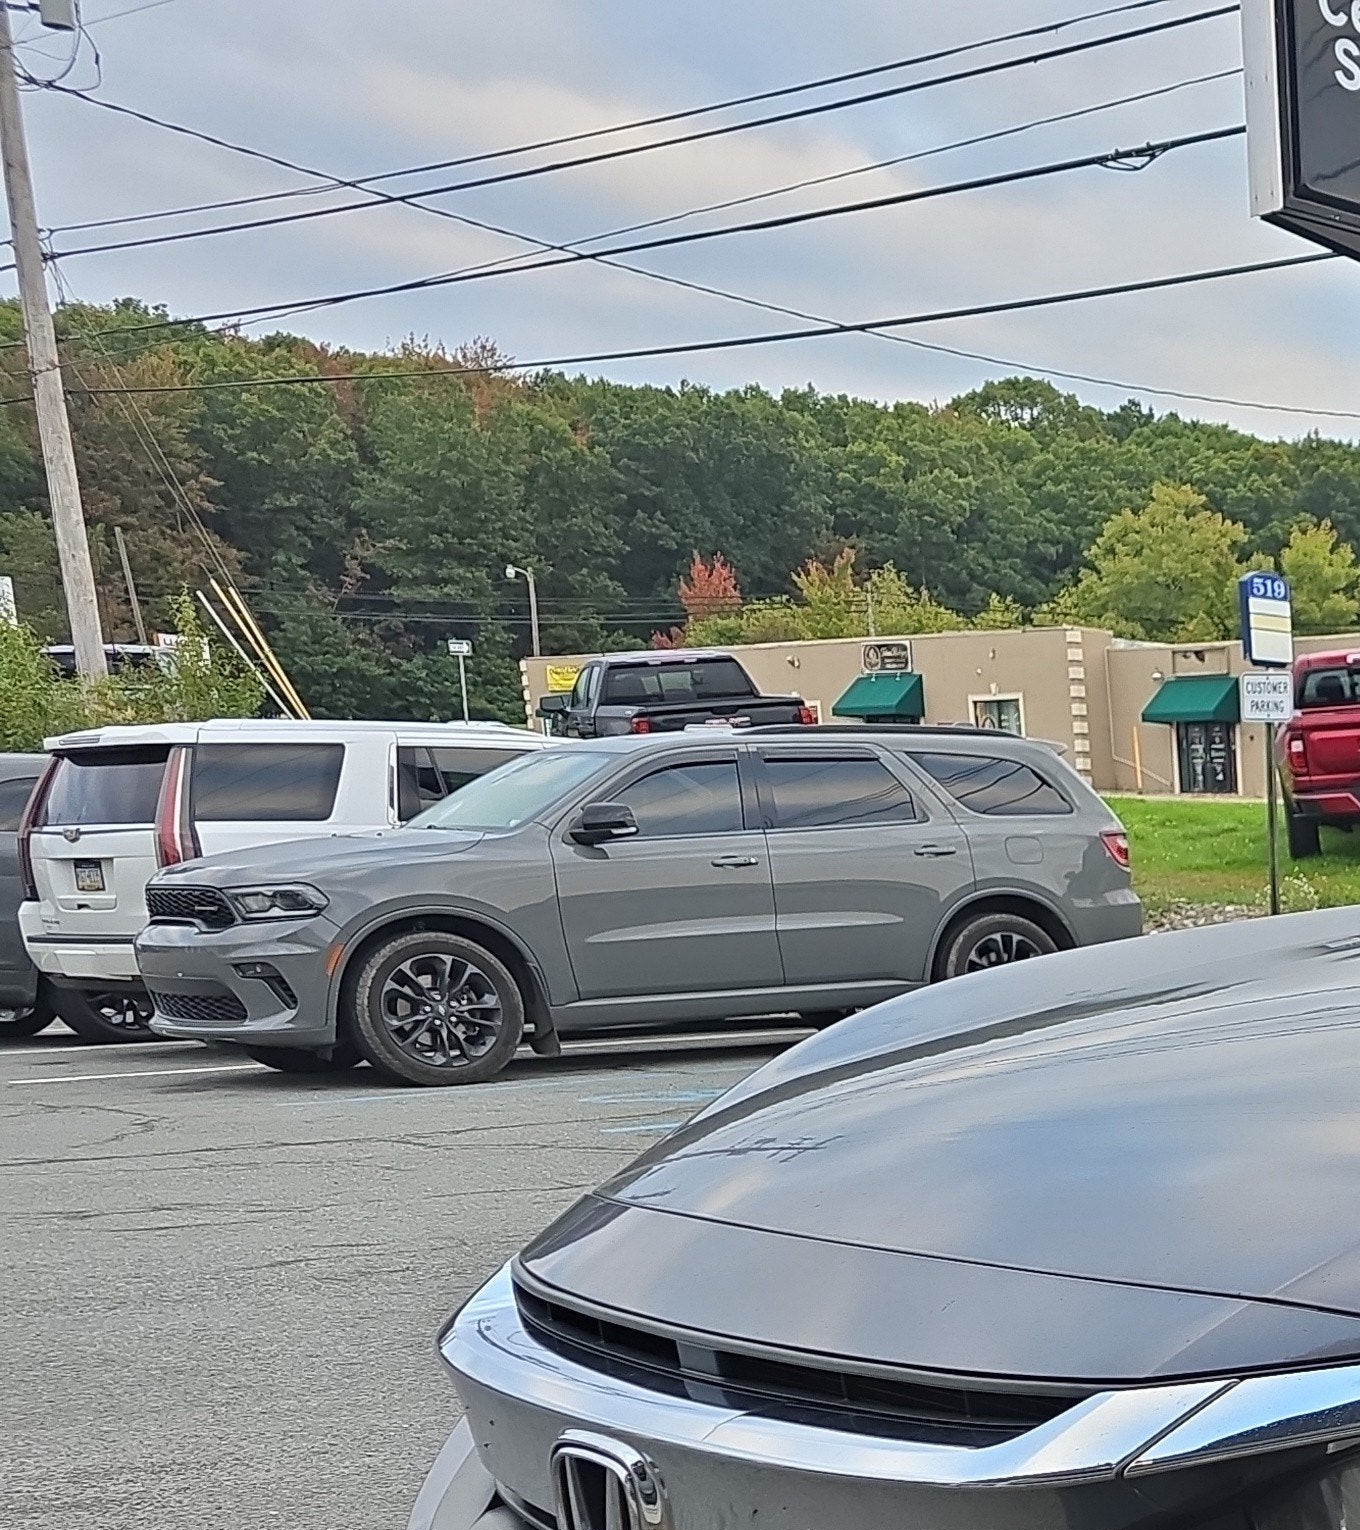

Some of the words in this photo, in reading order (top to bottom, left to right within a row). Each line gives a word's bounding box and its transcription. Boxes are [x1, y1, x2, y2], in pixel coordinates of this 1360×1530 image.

[1252, 577, 1286, 599] 519
[1245, 680, 1289, 695] CUSTOMER
[1250, 699, 1285, 713] PARKING
